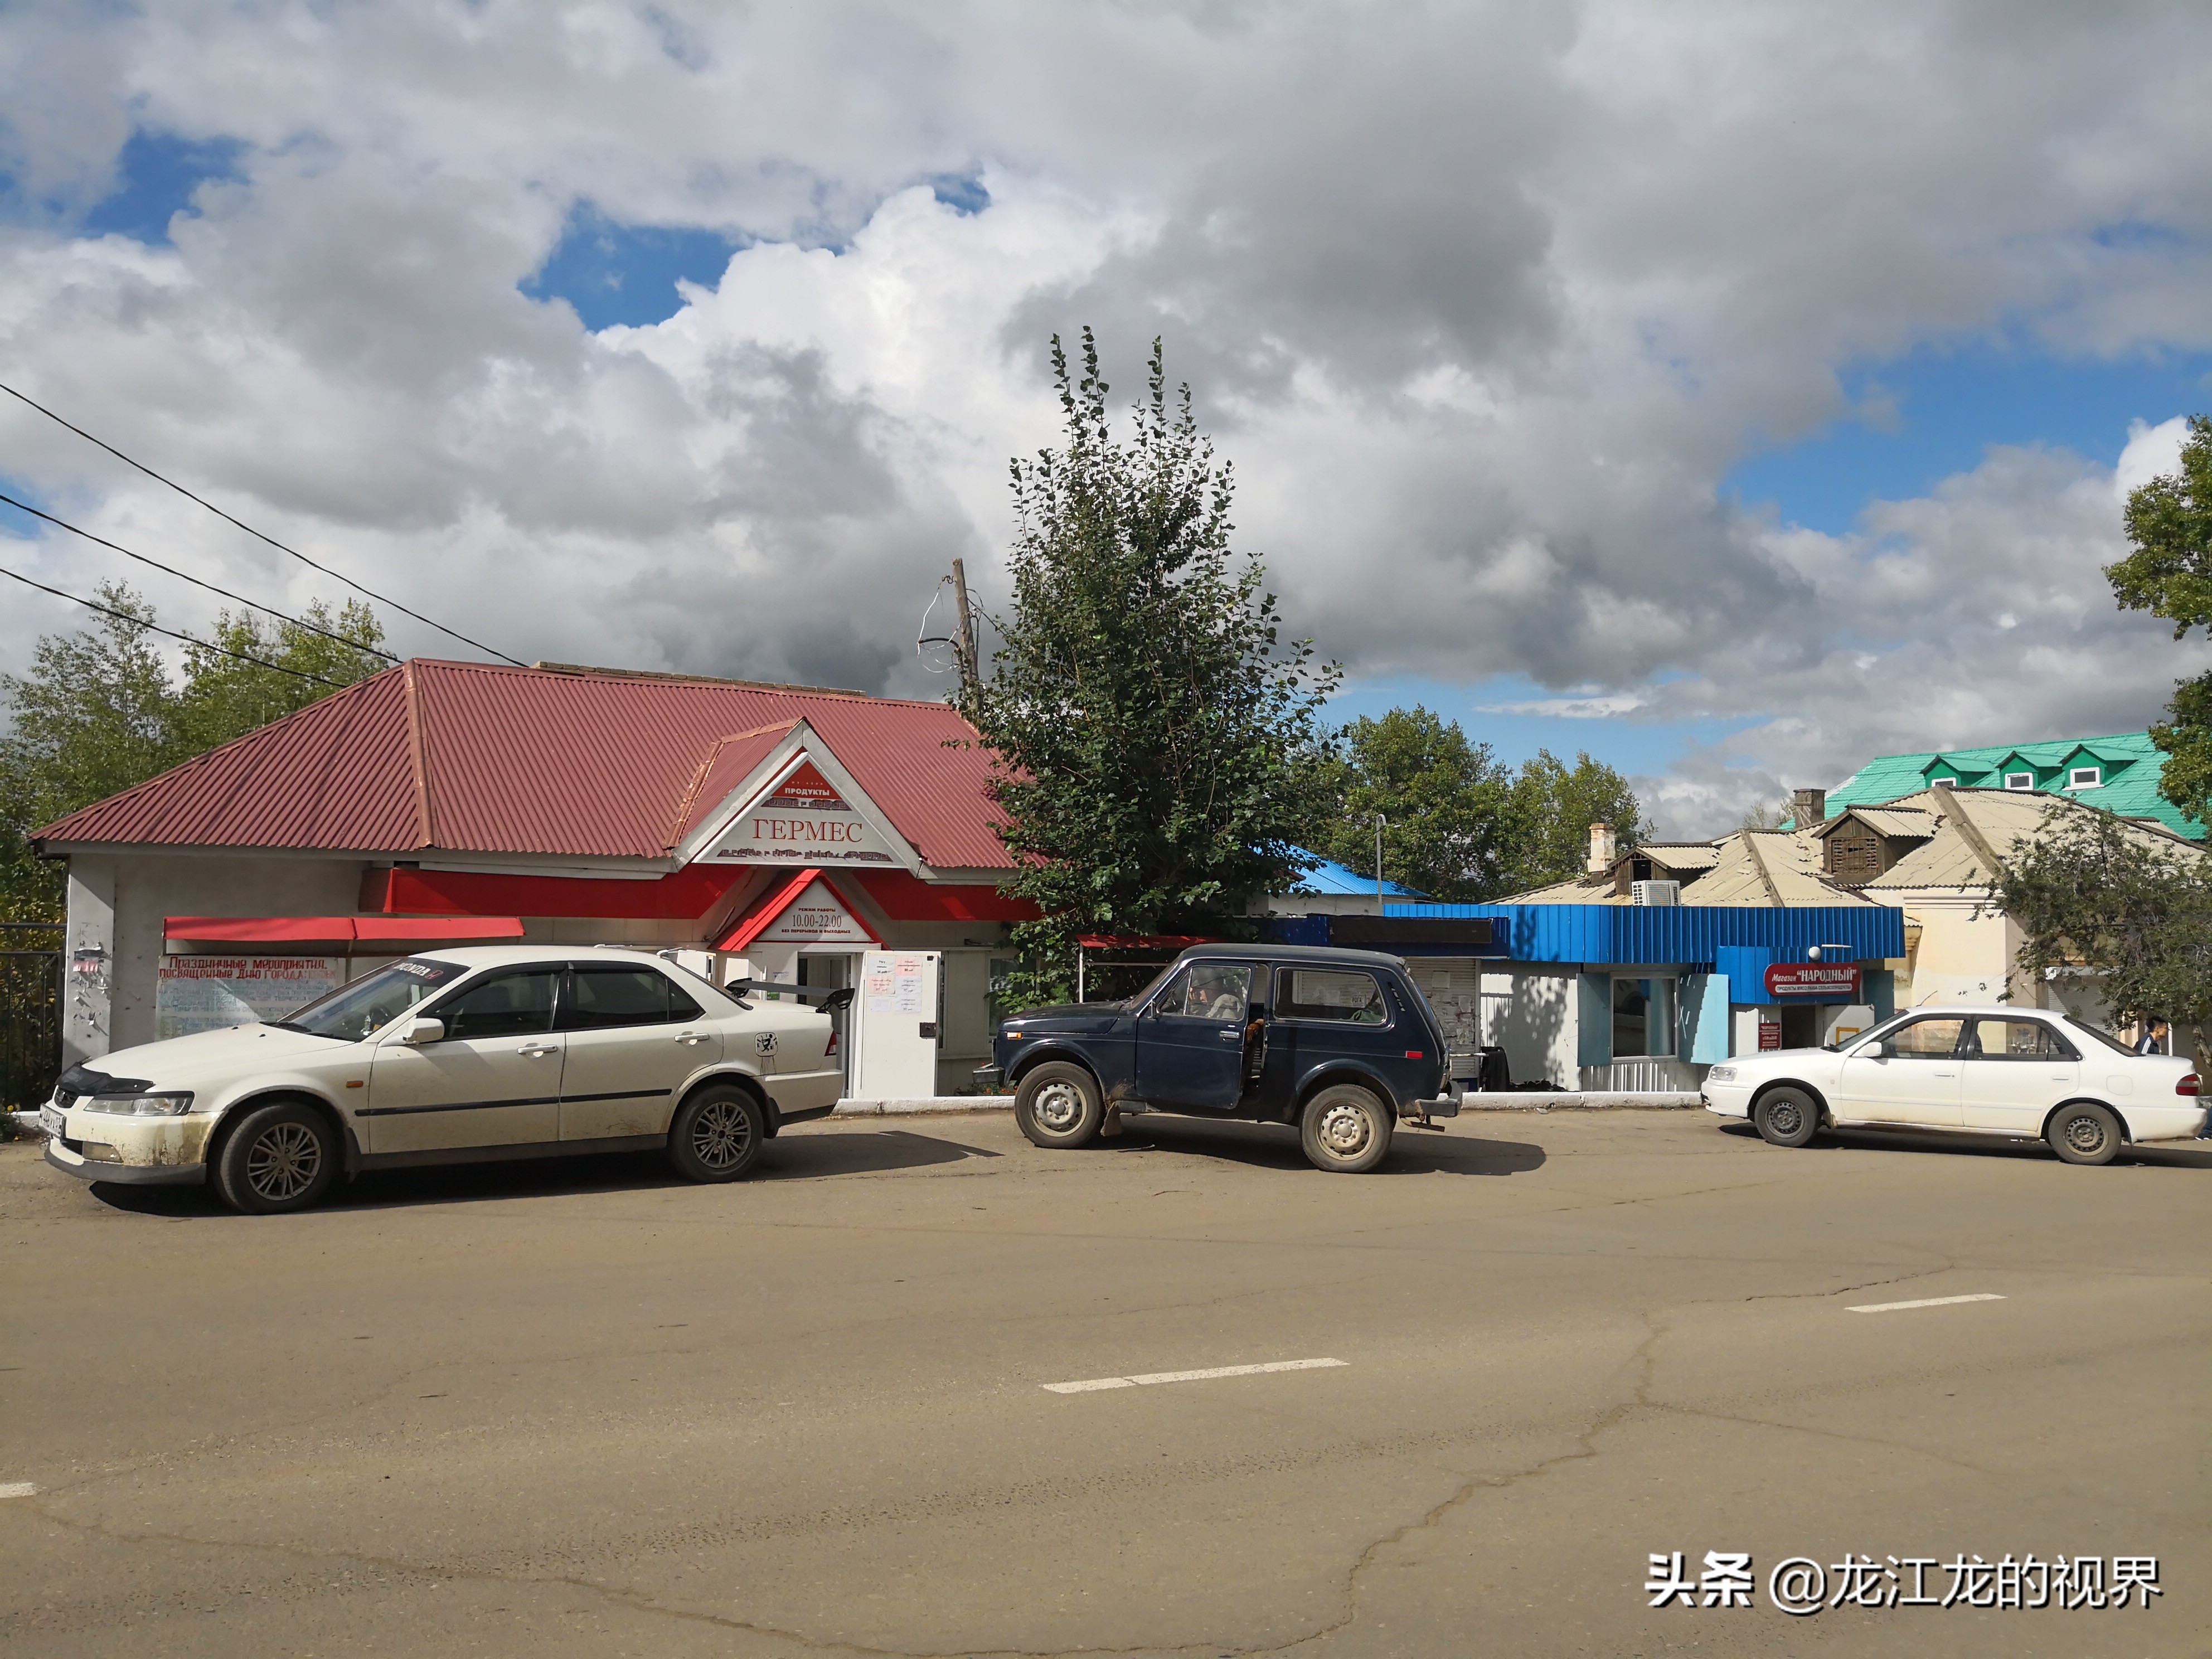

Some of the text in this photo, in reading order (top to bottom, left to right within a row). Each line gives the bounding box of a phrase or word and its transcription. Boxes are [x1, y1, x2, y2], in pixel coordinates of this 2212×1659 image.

[785, 787, 830, 796] ПРОДУКТЫ
[753, 818, 863, 843] ГЕРМЕС
[792, 914, 842, 928] 10.00-22.00
[169, 957, 247, 969] Праздничные
[393, 963, 431, 977] HONDA
[1772, 973, 1797, 982] Магазин
